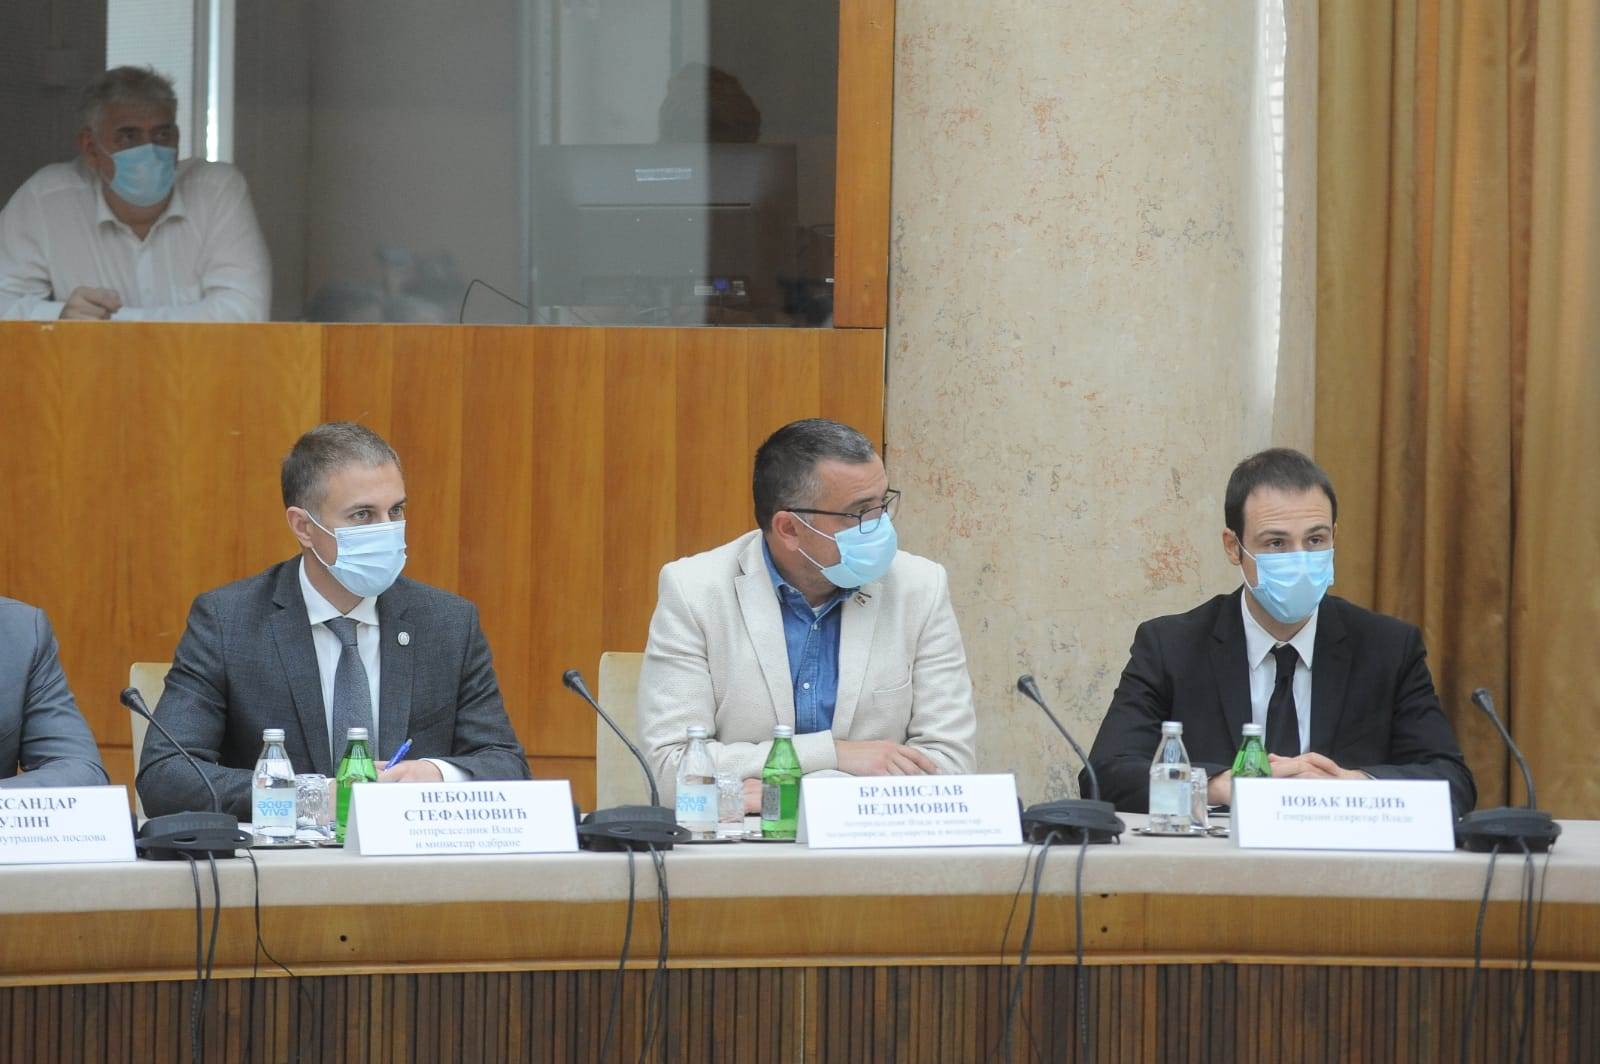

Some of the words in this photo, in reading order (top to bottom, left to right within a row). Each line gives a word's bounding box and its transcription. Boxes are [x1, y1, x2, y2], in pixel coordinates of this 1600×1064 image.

[421, 791, 507, 803] НЕБОЈША
[859, 785, 963, 798] БРАНИСЛАВ
[0, 797, 77, 810] САНДАР
[257, 799, 292, 809] aqua
[857, 802, 968, 815] НЕДИМОВИЋ
[1281, 795, 1340, 807] НОВАК
[1346, 796, 1406, 809] НЕДИЋ
[261, 808, 288, 816] viva
[404, 808, 527, 821] СТЕФАНОВИЋ
